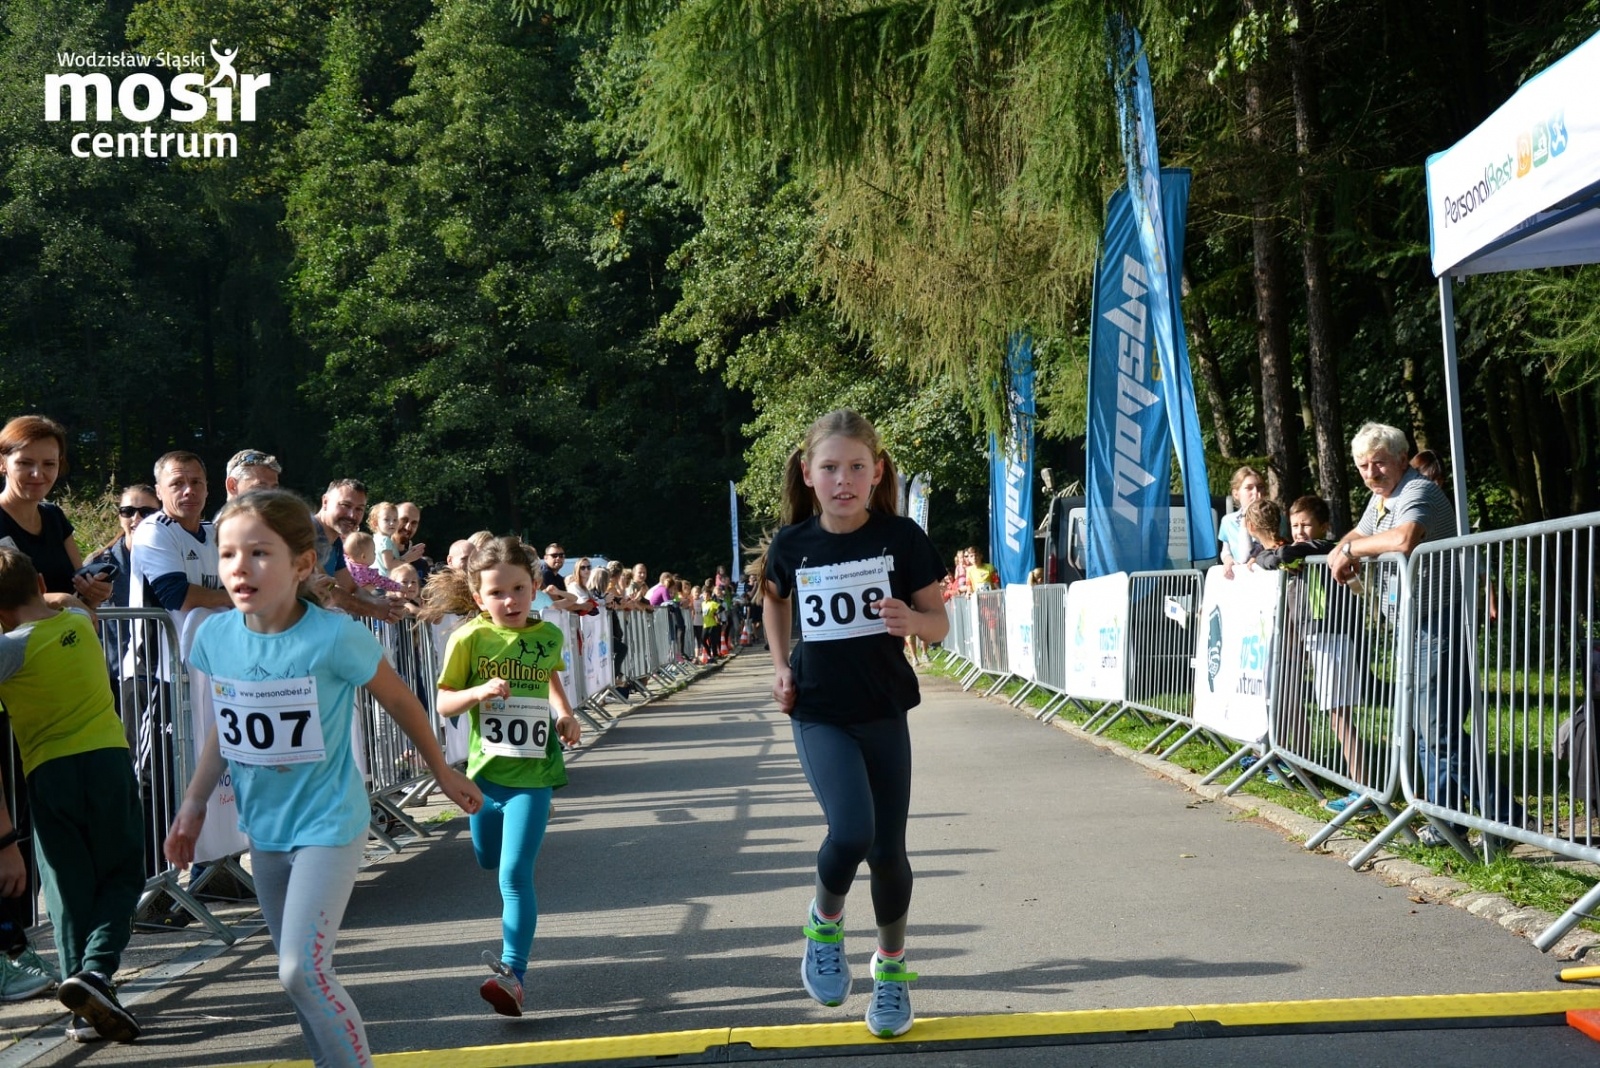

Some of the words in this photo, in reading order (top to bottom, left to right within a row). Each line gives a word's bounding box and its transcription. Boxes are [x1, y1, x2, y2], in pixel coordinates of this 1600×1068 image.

[1444, 153, 1514, 229] PersonalBest
[824, 567, 884, 580] www.personalbest.pl
[804, 587, 885, 627] 308
[239, 687, 312, 699] www.personalbest.pl
[220, 708, 312, 750] 307
[485, 718, 548, 747] 306
